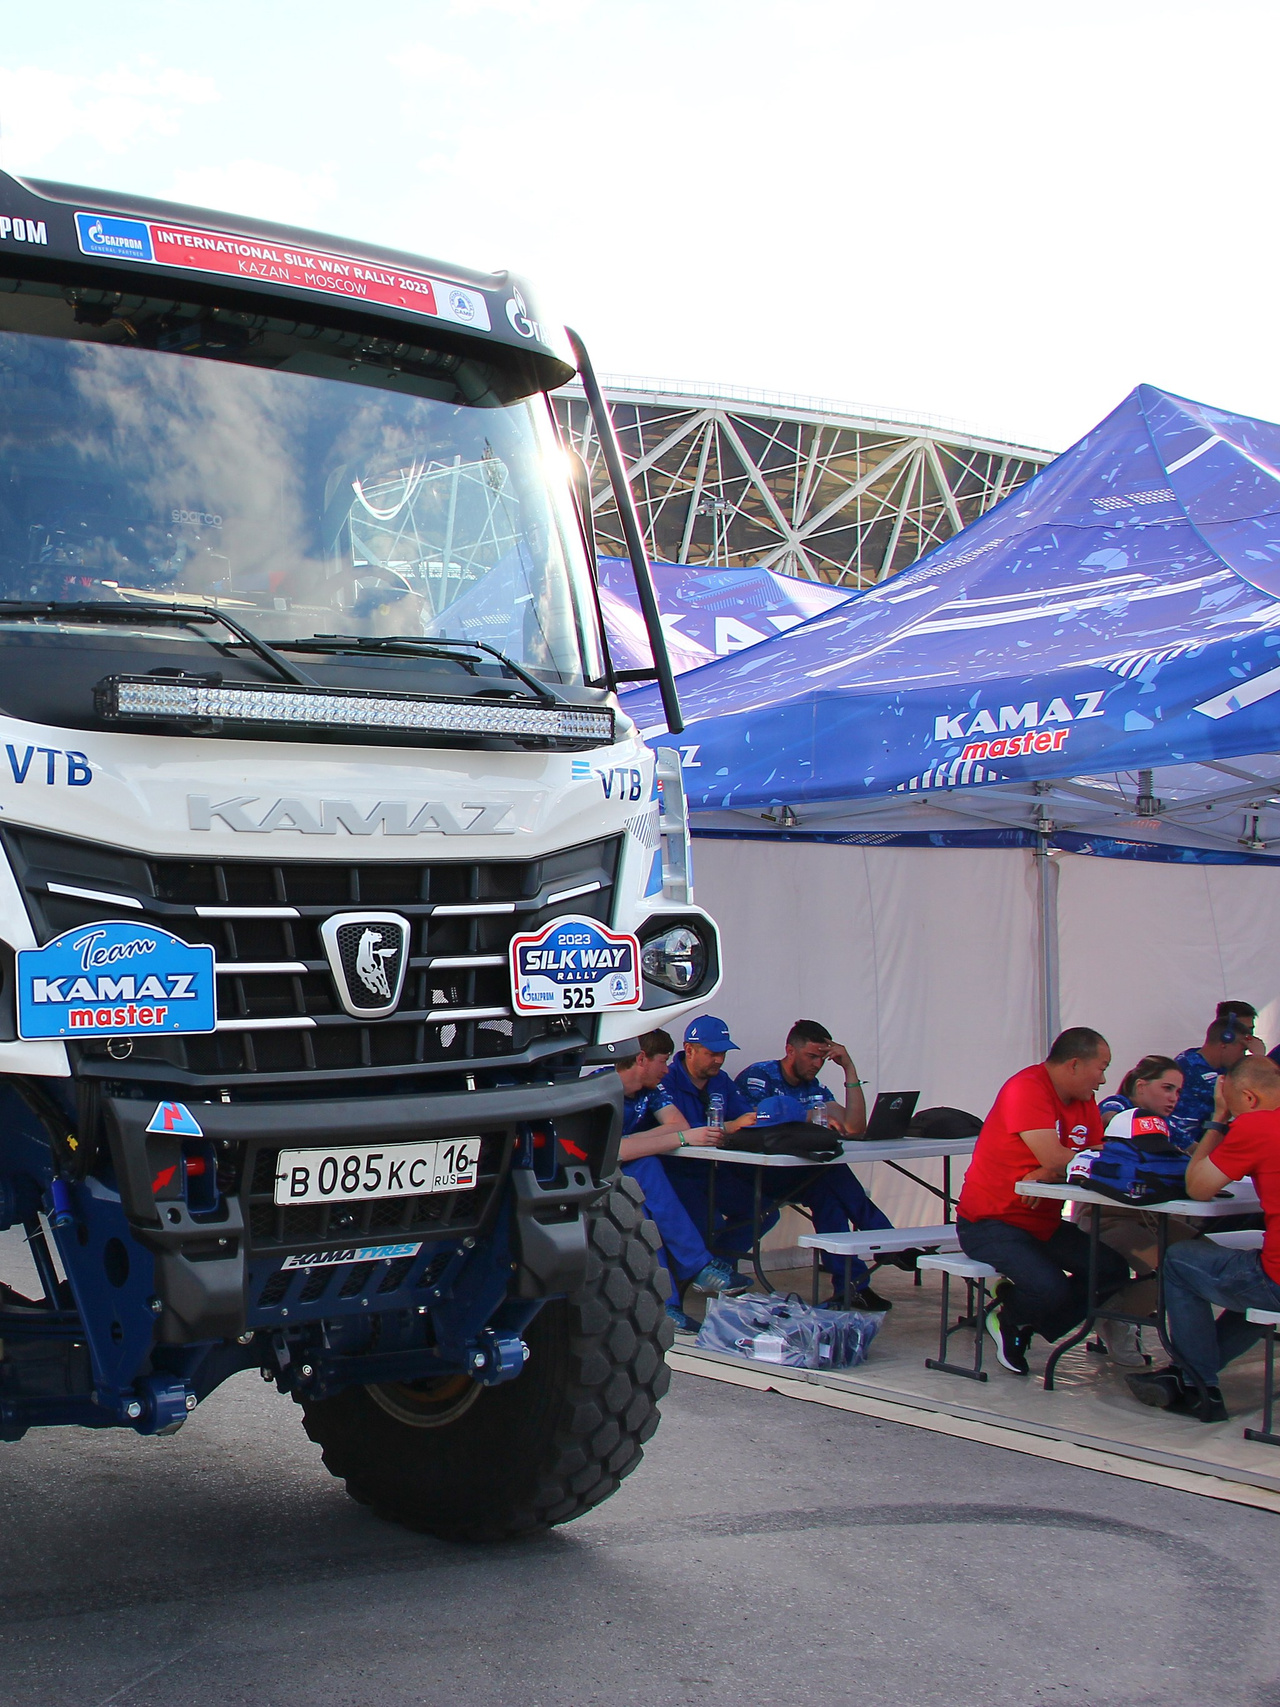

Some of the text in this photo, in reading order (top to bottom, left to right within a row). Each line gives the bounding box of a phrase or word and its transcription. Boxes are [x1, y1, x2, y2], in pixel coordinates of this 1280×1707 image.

[104, 235, 143, 250] GAZPROM
[157, 230, 430, 295] INTERNATIONAL SILK WAY RALLY 2023
[238, 260, 290, 280] KAZAN
[304, 274, 367, 296] MOSCOW
[171, 509, 223, 526] sparco
[934, 690, 1106, 742] KAMAZ
[961, 727, 1070, 763] master
[5, 744, 94, 787] VTB
[594, 767, 641, 801] VTB
[187, 793, 517, 837] KAMAZ
[73, 930, 157, 972] Team
[558, 934, 591, 945] 2023
[525, 948, 627, 971] SILK WAY
[32, 974, 198, 1004] KAMAZ
[556, 971, 598, 981] RALLY
[530, 992, 555, 1002] GAZPROM
[563, 987, 595, 1010] 525
[69, 1005, 168, 1029] master
[442, 1143, 469, 1174] 16
[434, 1174, 457, 1186] RUS
[358, 1242, 418, 1260] TYRES
